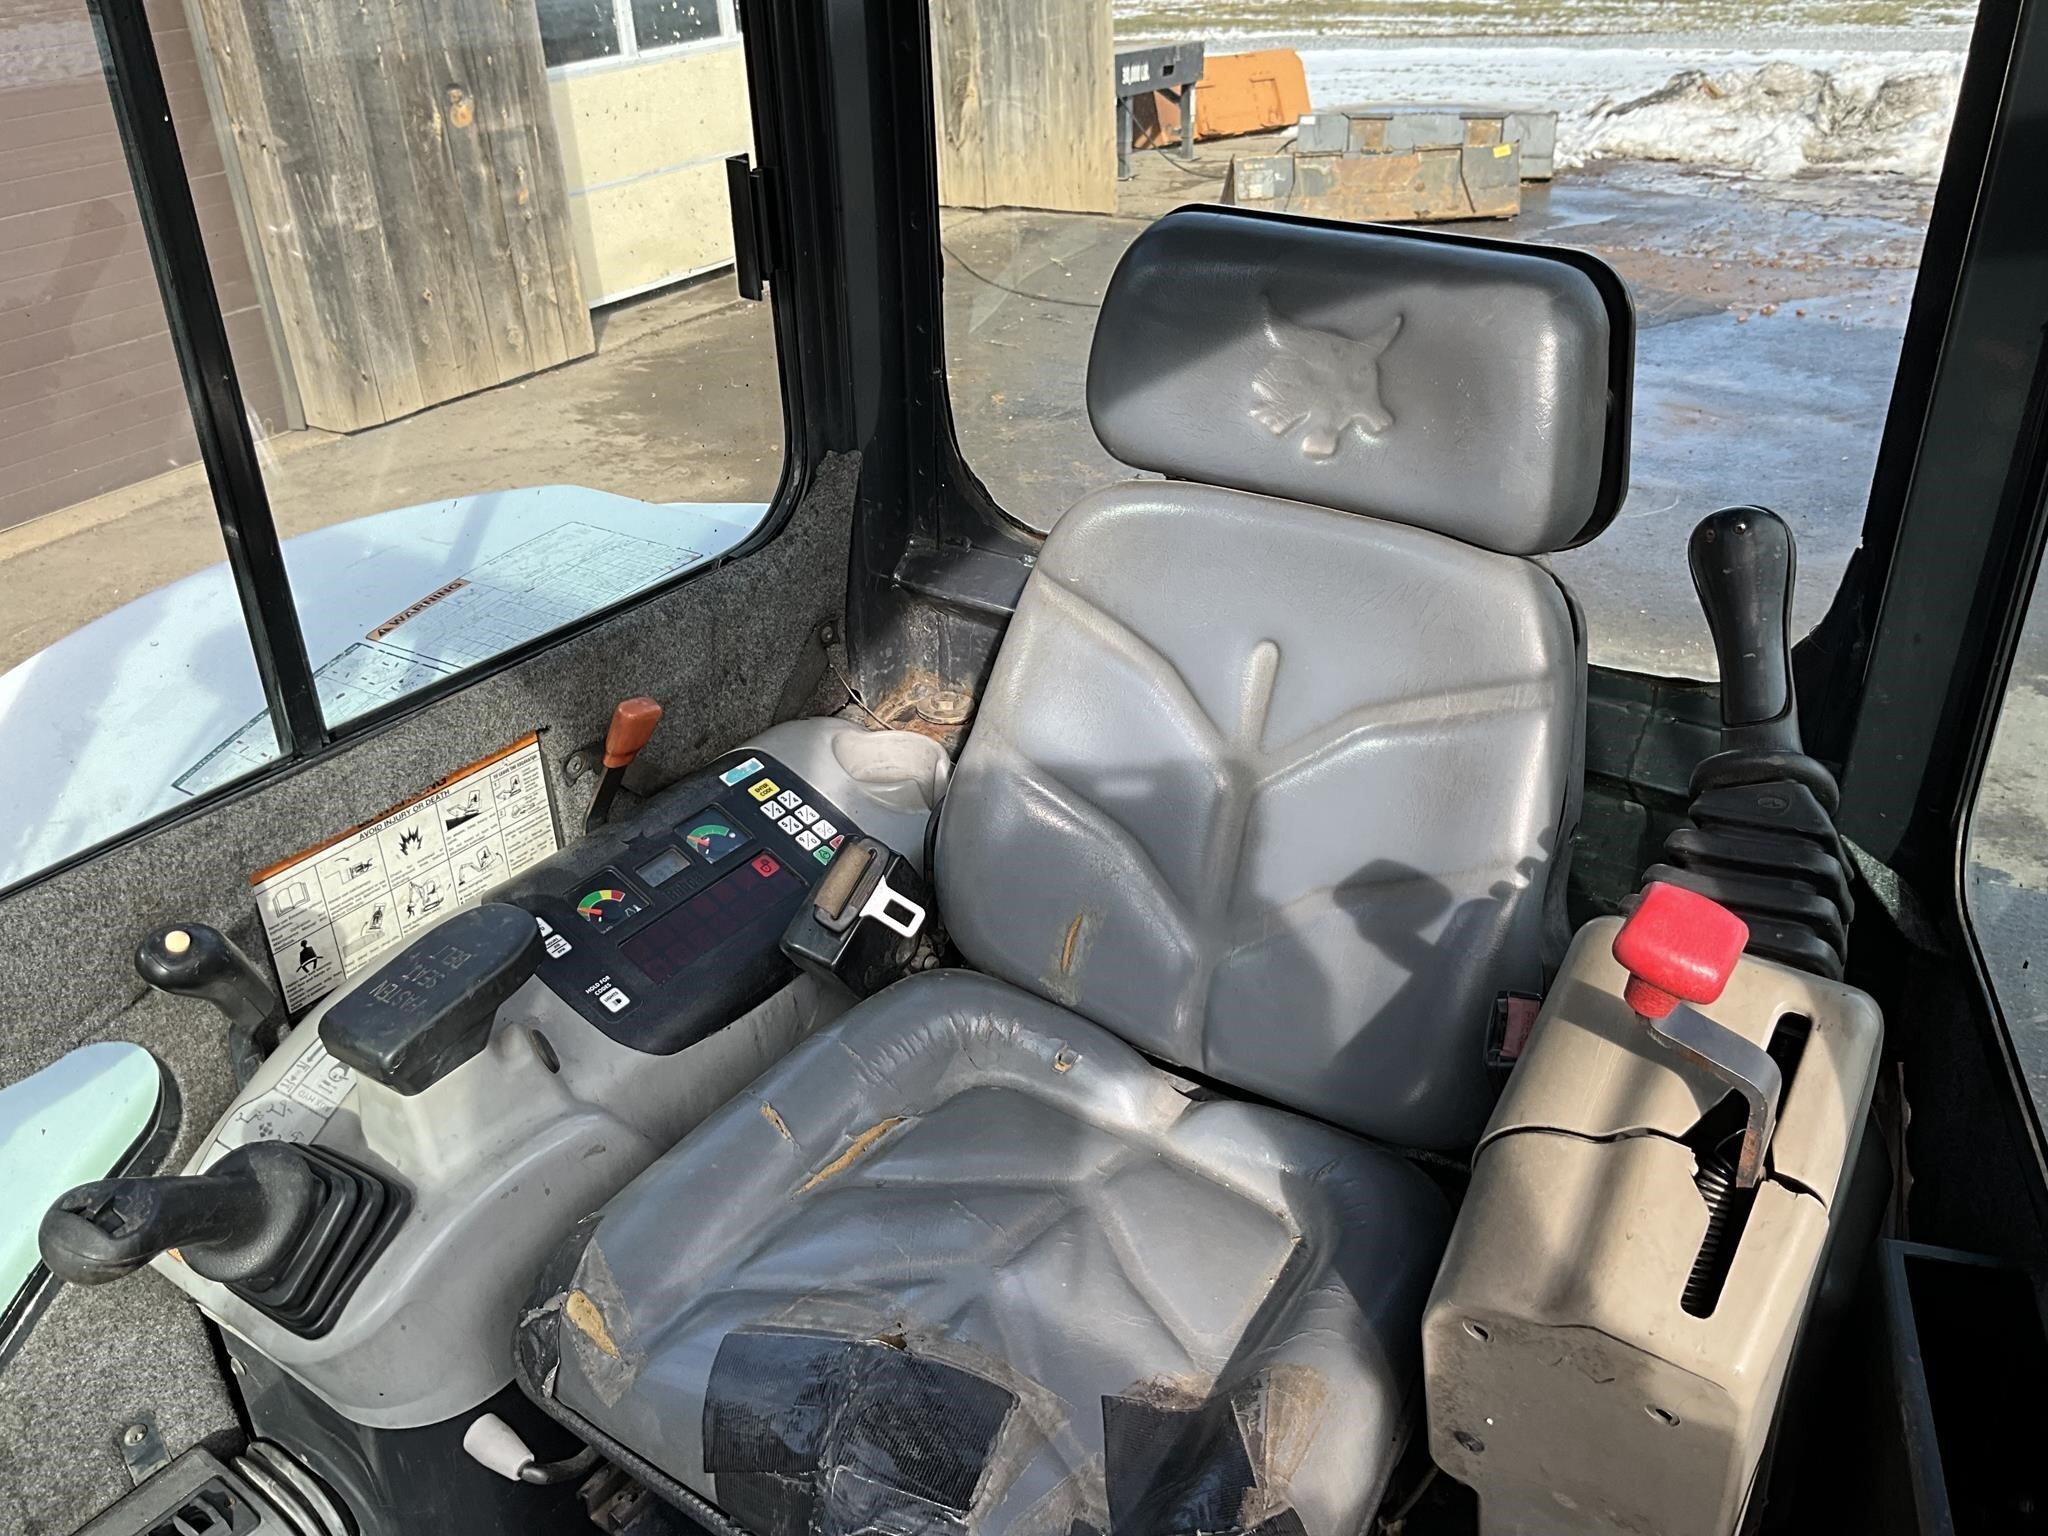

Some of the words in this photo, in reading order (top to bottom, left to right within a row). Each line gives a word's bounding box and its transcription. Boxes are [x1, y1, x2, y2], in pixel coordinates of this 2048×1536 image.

[388, 582, 463, 626] WARNING
[754, 782, 769, 793] ENTER
[759, 787, 774, 797] CODE
[359, 824, 383, 840] AVOID
[383, 809, 411, 827] INJURY
[412, 802, 424, 812] OR
[425, 789, 450, 806] DEATH
[585, 982, 600, 994] HOLD
[599, 975, 610, 985] FOR
[594, 983, 612, 996] CODES
